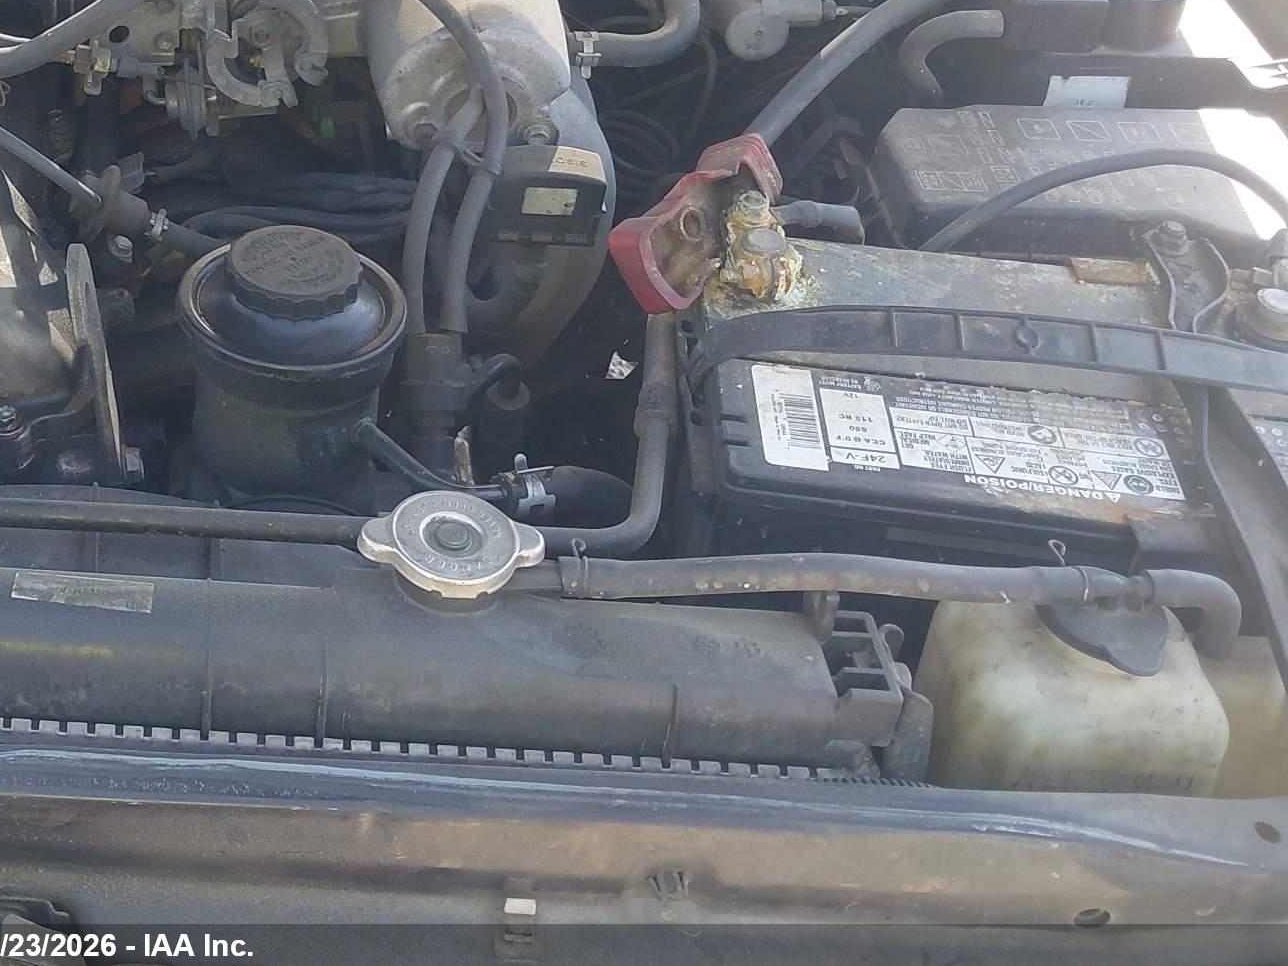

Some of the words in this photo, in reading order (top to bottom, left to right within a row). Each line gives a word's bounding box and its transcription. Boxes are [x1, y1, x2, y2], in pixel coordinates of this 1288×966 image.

[838, 413, 852, 421] RC
[855, 415, 873, 423] 115
[848, 425, 868, 433] 650
[863, 438, 886, 446] CCA
[845, 452, 886, 464] 24F-V
[949, 452, 968, 460] WITH
[864, 465, 881, 473] PART
[948, 464, 972, 473] FLUSH
[1010, 465, 1043, 476] SULFURIC
[963, 474, 1105, 501] DANGER/POISON
